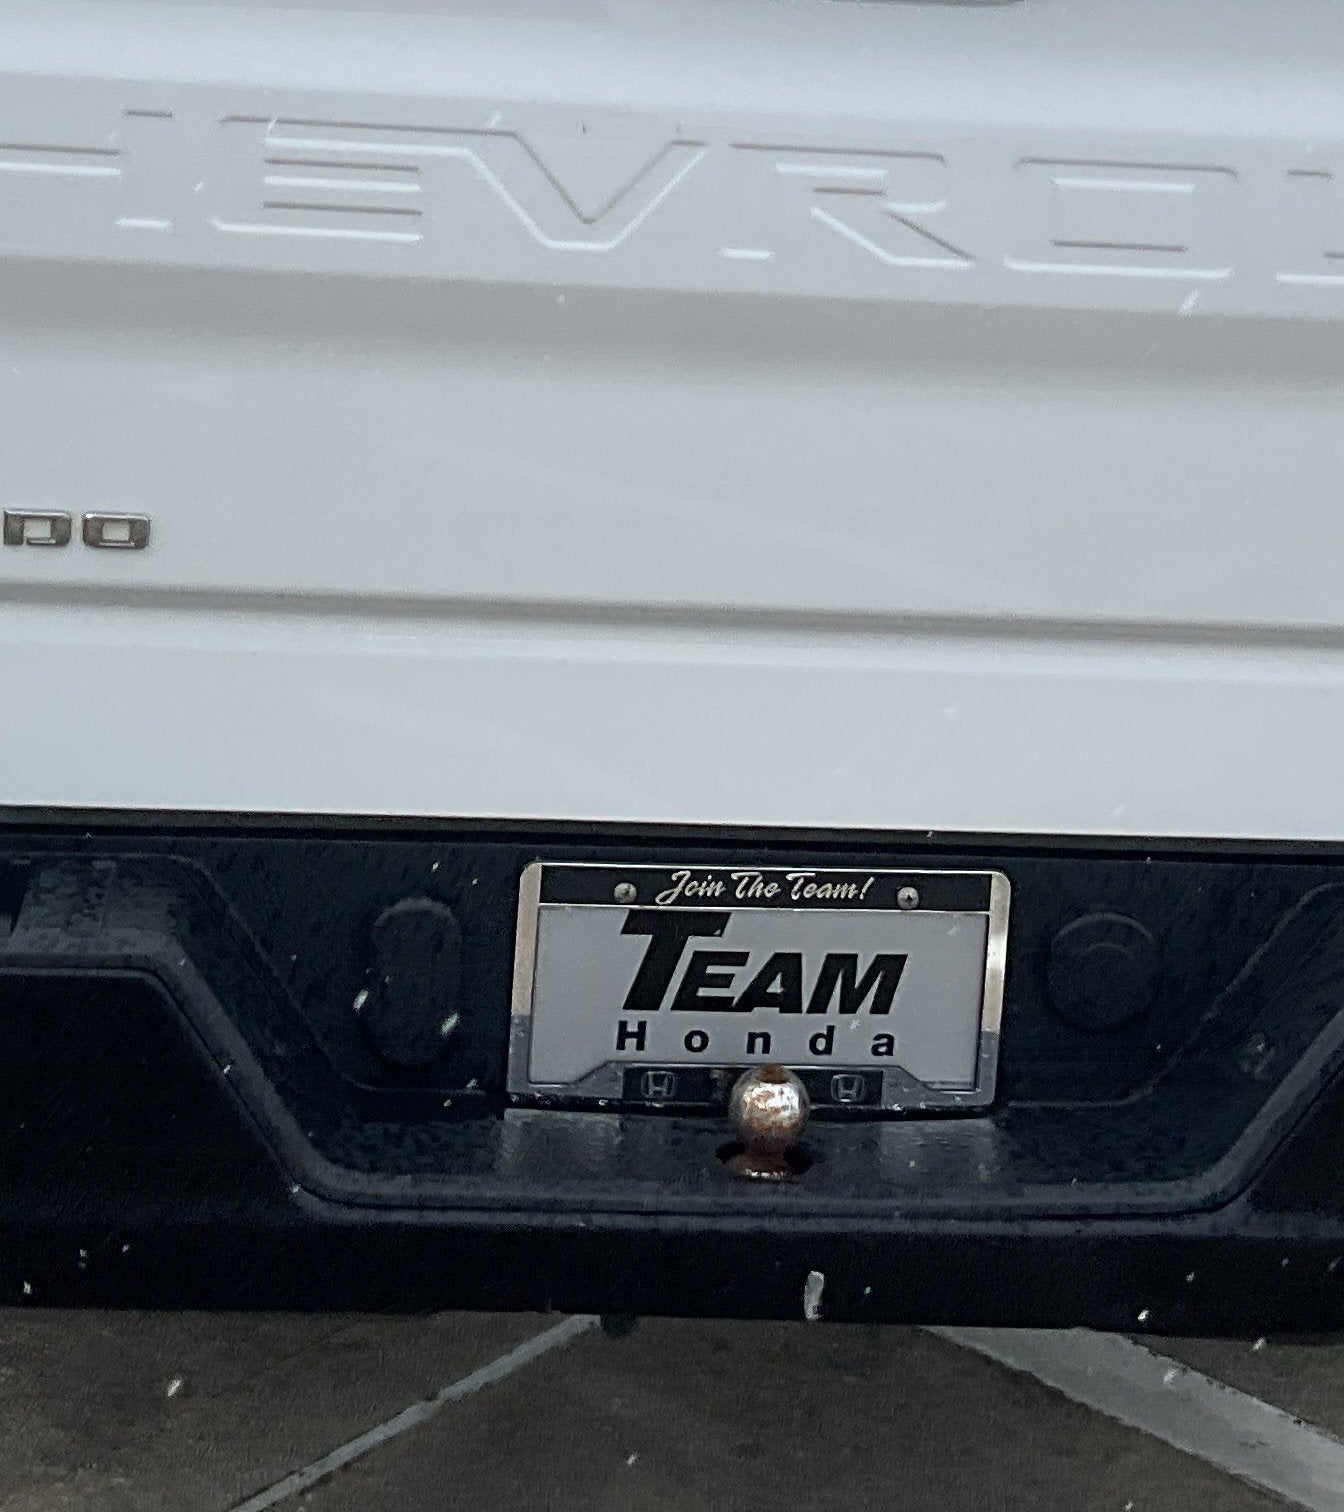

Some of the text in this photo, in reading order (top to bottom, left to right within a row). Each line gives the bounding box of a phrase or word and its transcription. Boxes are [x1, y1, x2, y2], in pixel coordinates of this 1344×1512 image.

[654, 870, 875, 905] Join The Team!
[620, 909, 908, 1015] TEAM
[615, 1020, 896, 1057] Honda
